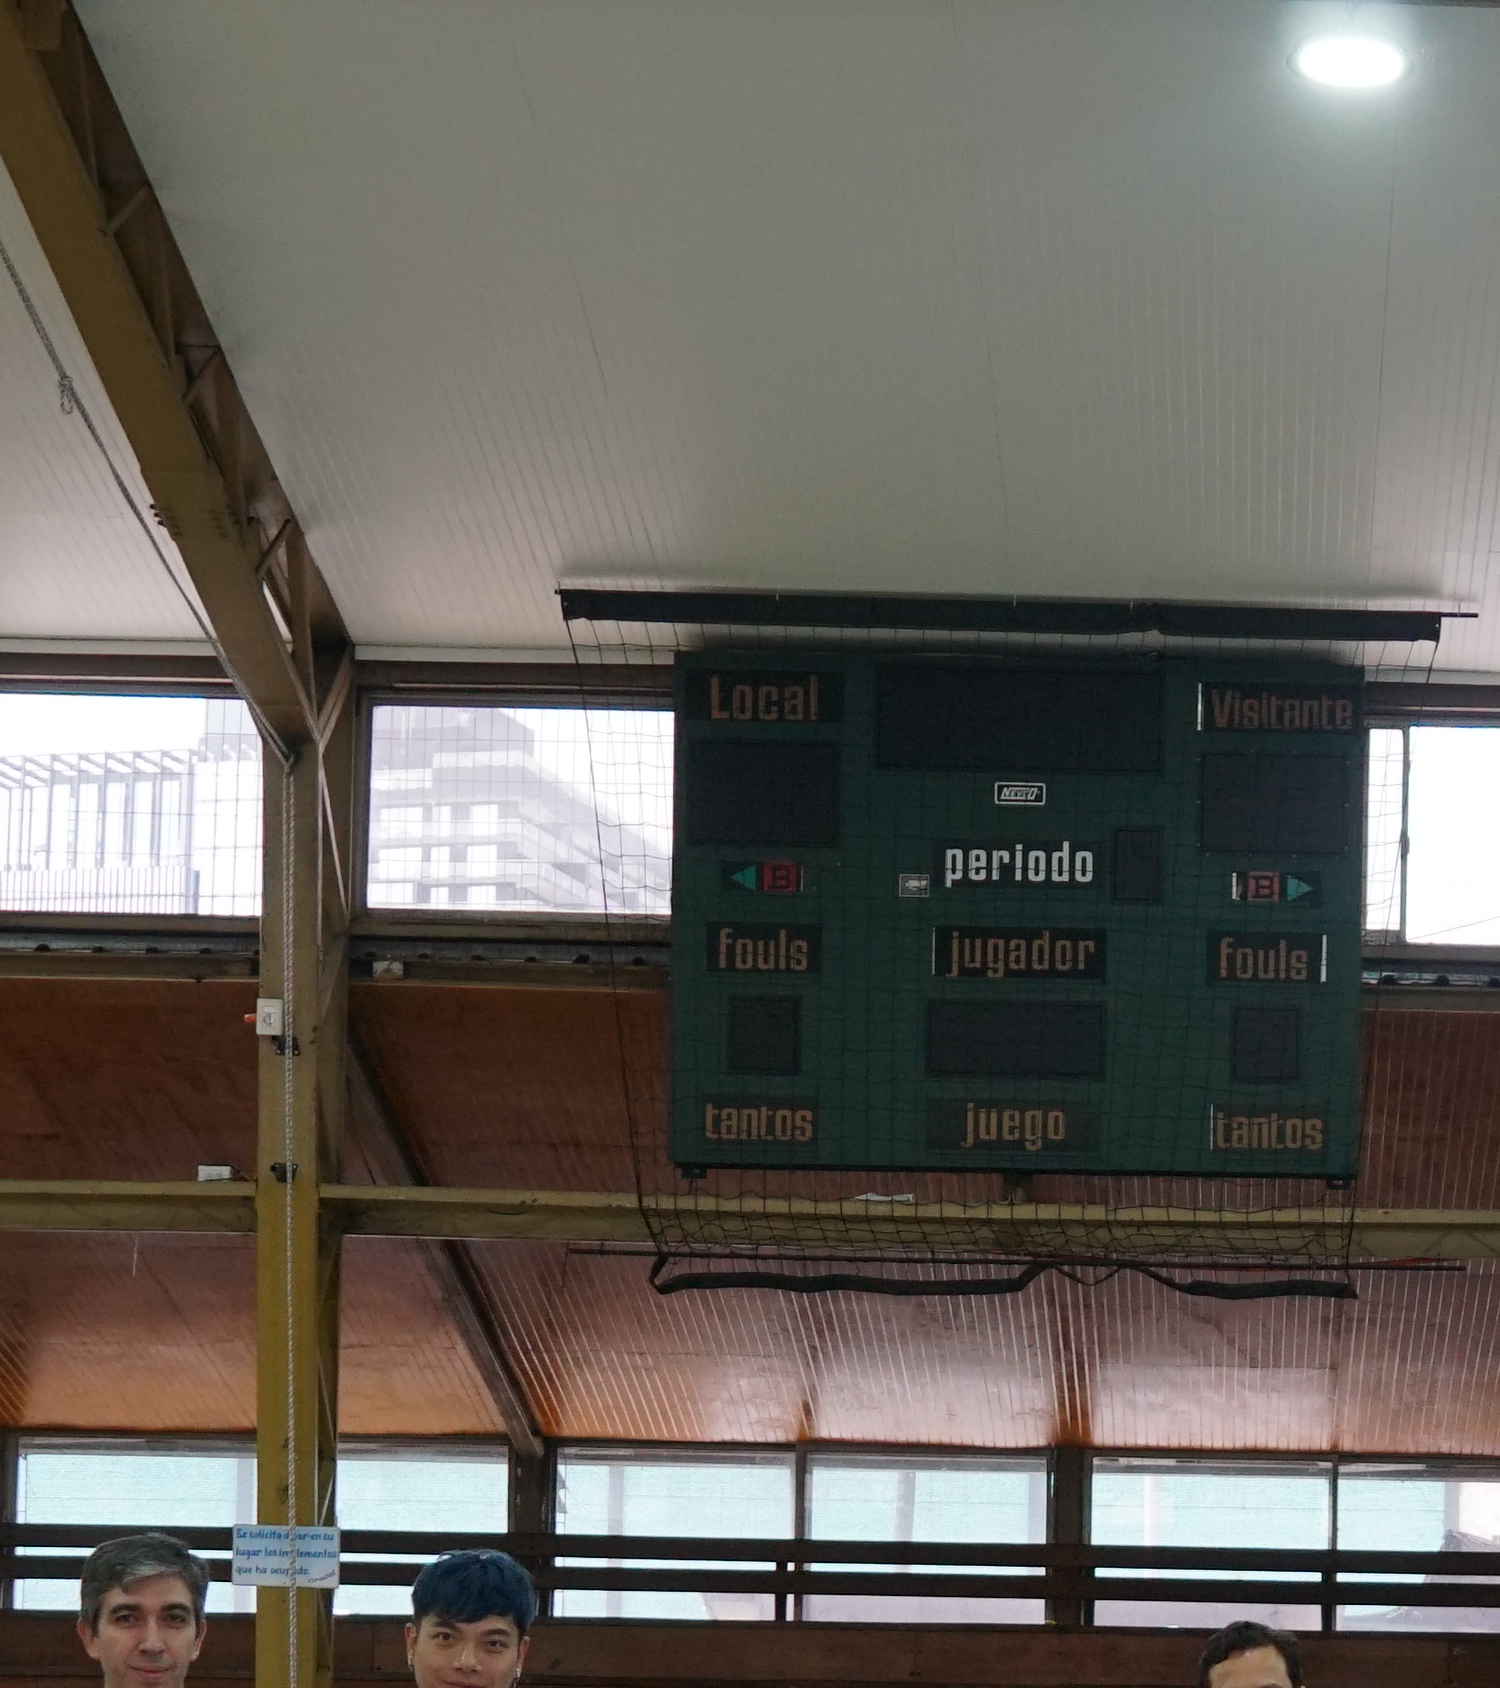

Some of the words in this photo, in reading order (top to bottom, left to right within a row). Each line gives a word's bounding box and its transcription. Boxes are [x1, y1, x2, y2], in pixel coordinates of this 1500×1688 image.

[710, 675, 818, 720] Local
[1211, 689, 1353, 729] Visitante
[945, 841, 1093, 887] periodo
[719, 928, 809, 971] fouls
[950, 931, 1095, 978] jugador
[1220, 937, 1308, 981] fouls
[705, 1103, 813, 1142] tantos
[961, 1103, 1066, 1151] juego
[1215, 1110, 1323, 1151] tantos
[235, 1546, 262, 1560] lugar
[265, 1548, 277, 1556] los
[279, 1548, 337, 1558] imlementos
[236, 1528, 247, 1539] Se
[283, 1529, 309, 1540] dar
[235, 1566, 252, 1576] que
